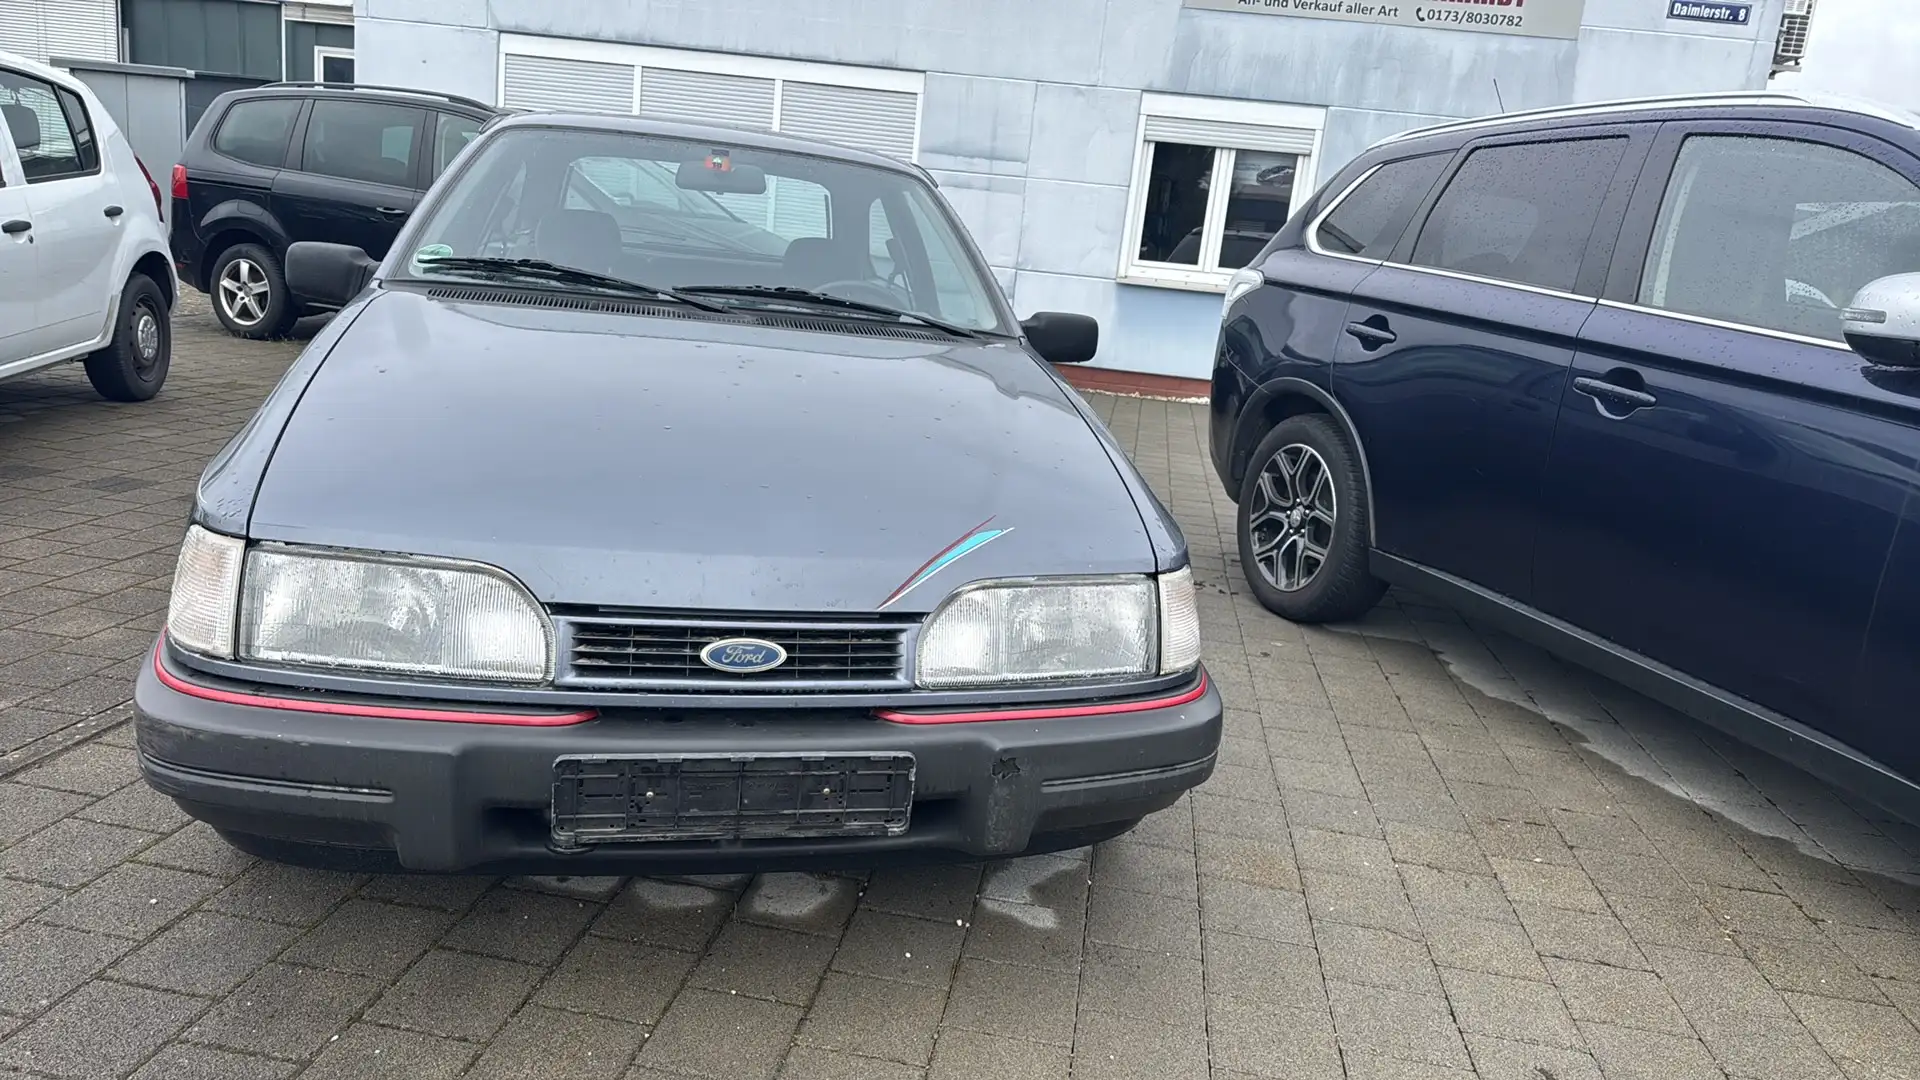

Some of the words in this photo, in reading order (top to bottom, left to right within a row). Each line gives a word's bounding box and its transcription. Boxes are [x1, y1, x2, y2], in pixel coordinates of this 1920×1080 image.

[1264, 0, 1288, 8] und
[1293, 0, 1343, 12] Verkauf
[1345, 3, 1375, 16] aller
[1377, 5, 1399, 18] Art
[1427, 9, 1523, 27] 0173/8030782
[1672, 2, 1733, 20] Daimlerstr.
[1738, 8, 1747, 21] 8
[721, 645, 766, 664] Ford
